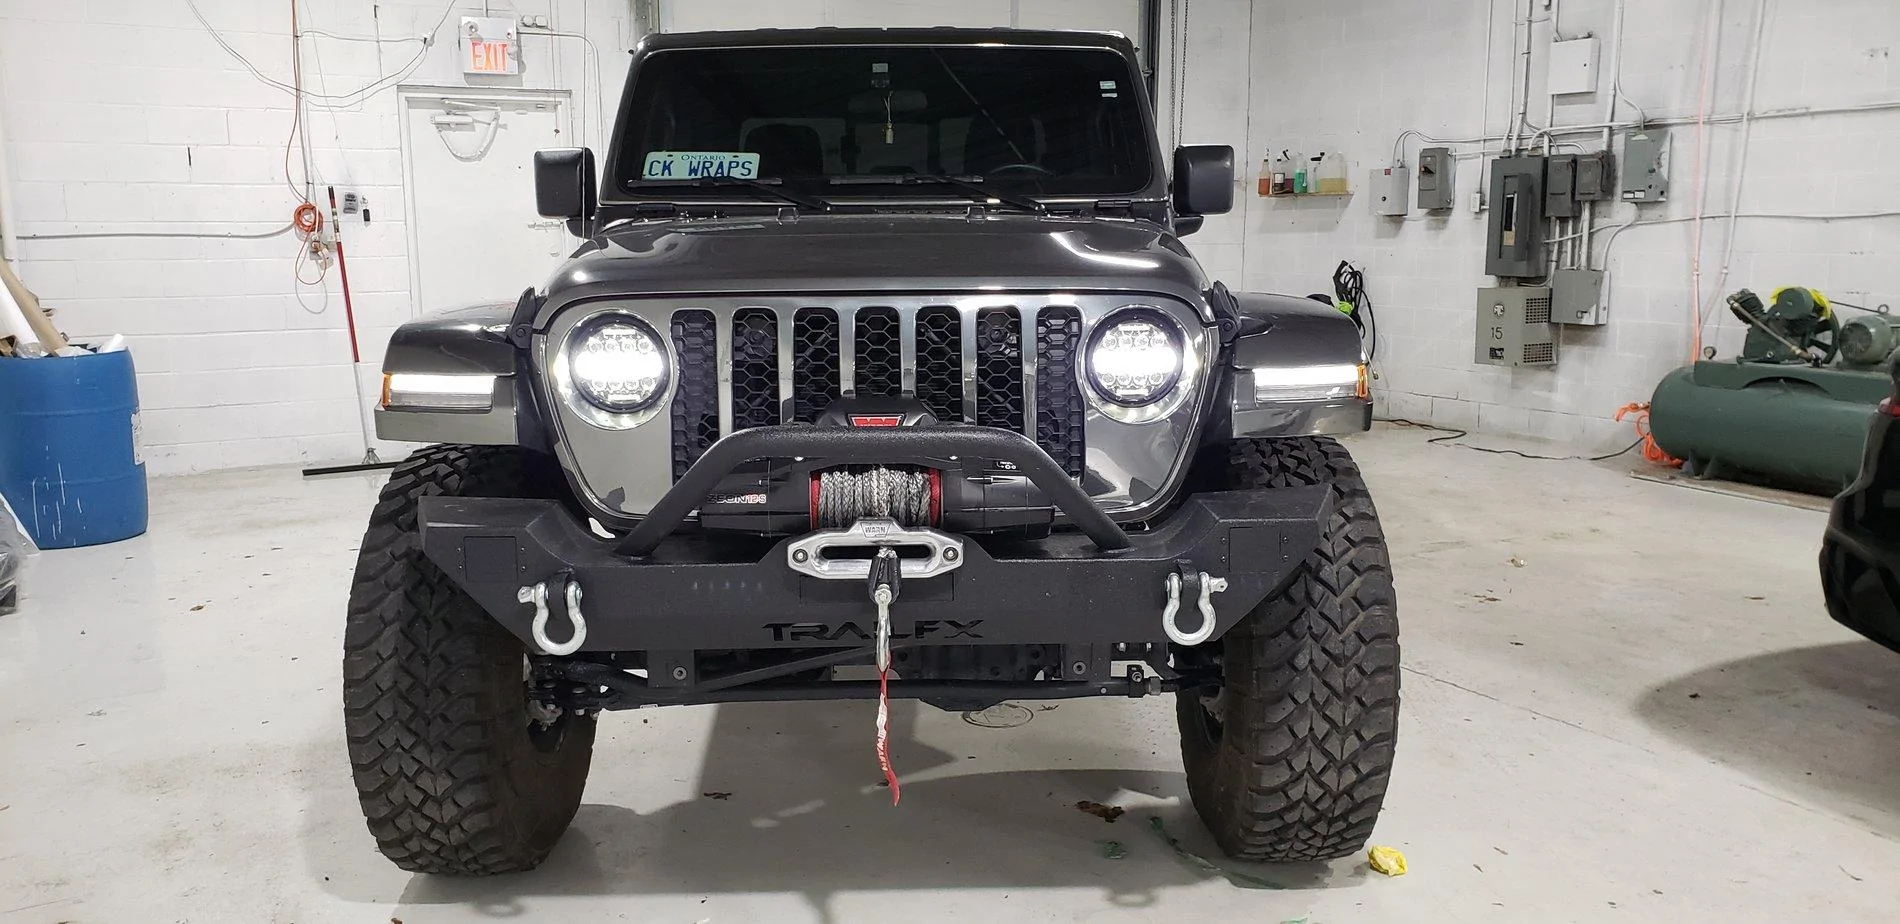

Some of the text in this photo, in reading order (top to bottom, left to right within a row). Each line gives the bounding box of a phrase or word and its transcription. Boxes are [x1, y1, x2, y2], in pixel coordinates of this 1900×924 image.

[471, 41, 508, 71] EXIT
[648, 160, 753, 177] CK WRAPS
[1491, 326, 1503, 340] 15
[865, 526, 886, 534] WARN
